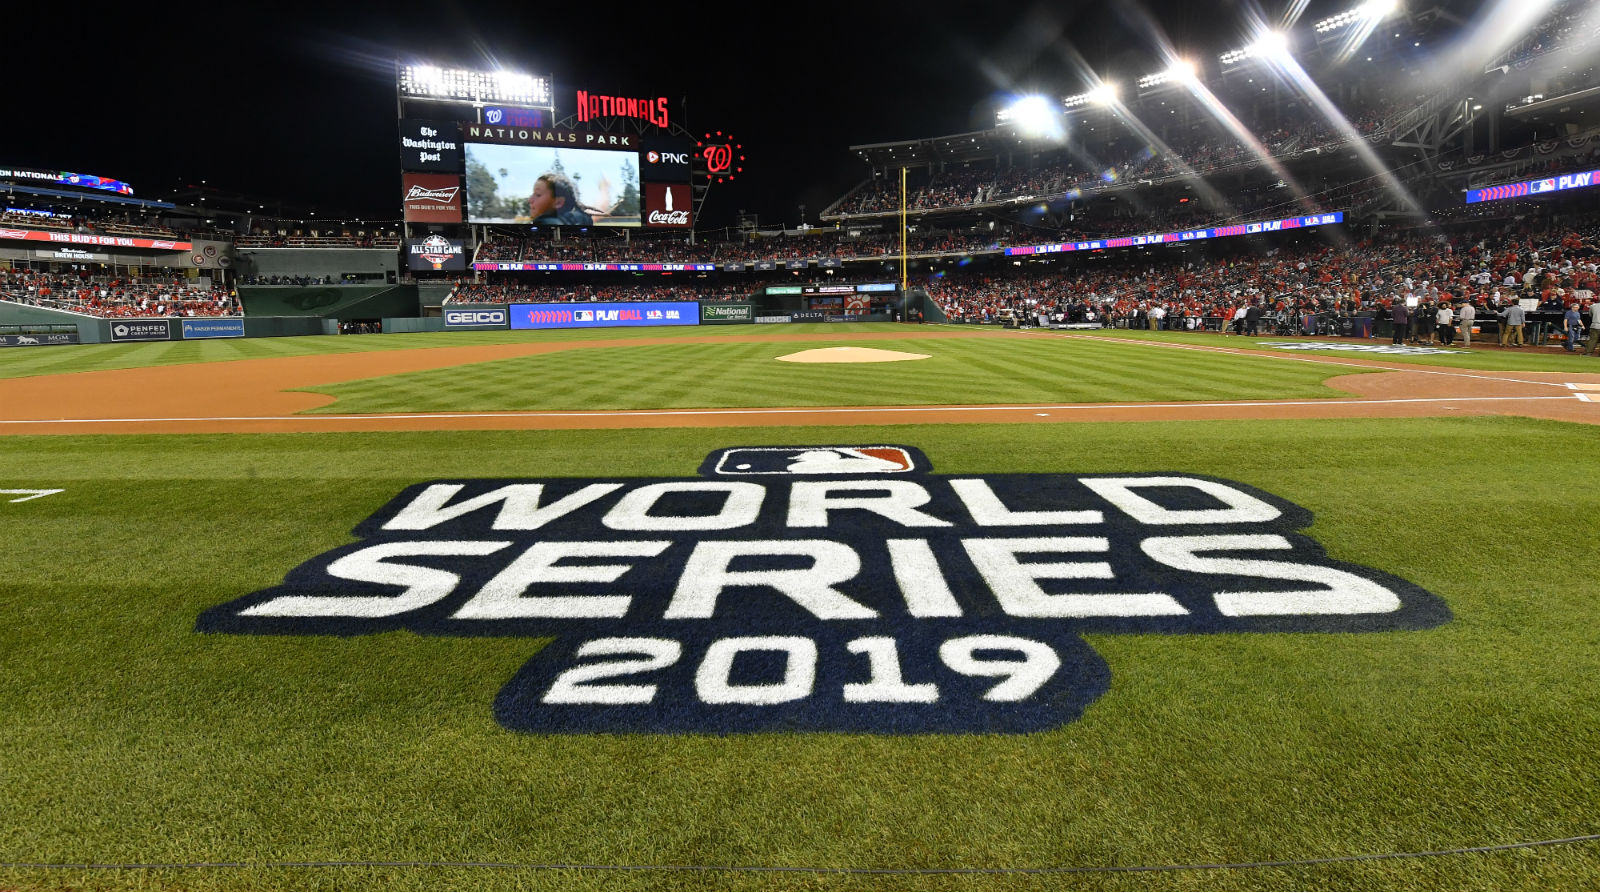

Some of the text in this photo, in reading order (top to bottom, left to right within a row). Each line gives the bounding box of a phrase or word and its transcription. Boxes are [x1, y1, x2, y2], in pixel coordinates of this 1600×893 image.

[577, 90, 668, 128] NATIONALS
[420, 126, 438, 137] The
[470, 126, 630, 146] NATIONALS PARK
[402, 136, 456, 151] Washington
[419, 151, 441, 163] Post
[661, 152, 689, 165] PNC
[14, 170, 64, 181] NATIONALS
[1559, 172, 1591, 189] PLAY
[410, 186, 453, 199] Budweiser
[1263, 221, 1282, 232] PLAY
[49, 232, 135, 247] THIS BUD'S FOR YOU.
[1147, 235, 1164, 244] PLAY
[54, 251, 94, 260] BREW HOUSE
[443, 245, 462, 254] GAME
[596, 309, 642, 321] PLAY BALL
[716, 306, 749, 316] National
[447, 312, 504, 324] GEICO
[130, 324, 166, 332] PENFED
[381, 475, 1285, 531] WORLD
[238, 537, 1403, 620] SERIES
[542, 634, 1062, 705] 2019
